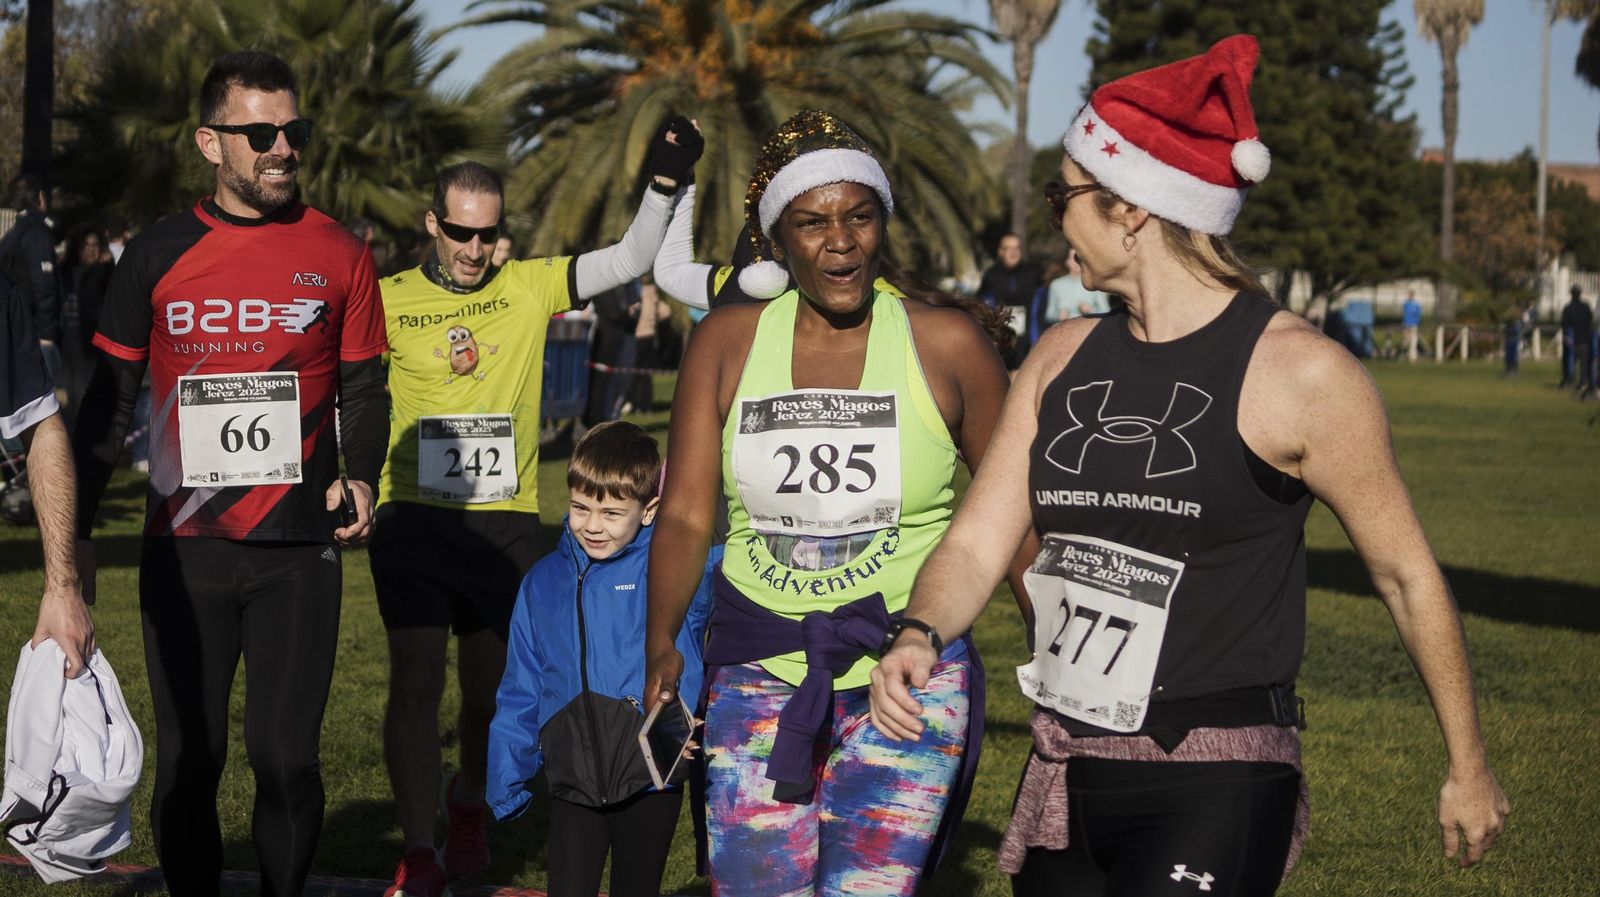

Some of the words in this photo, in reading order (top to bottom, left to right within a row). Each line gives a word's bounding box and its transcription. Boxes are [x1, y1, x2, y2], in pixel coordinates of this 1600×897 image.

[166, 298, 272, 335] B2B
[173, 341, 265, 354] RUNNING
[202, 381, 243, 394] Reyes
[247, 379, 293, 390] Magos
[238, 387, 267, 397] 2025
[772, 399, 824, 413] Reyes
[829, 398, 891, 414] Magos
[773, 411, 813, 422] Jerez
[818, 409, 856, 421] 2025
[220, 413, 271, 453] 66
[443, 447, 502, 478] 242
[772, 443, 877, 494] 285
[1036, 490, 1099, 507] UNDER
[1102, 492, 1201, 518] ARMOUR
[759, 527, 900, 598] Adventures
[1092, 566, 1131, 586] 2025
[1108, 556, 1171, 586] Magos
[614, 583, 636, 591] WEDZE
[1048, 597, 1139, 676] 277
